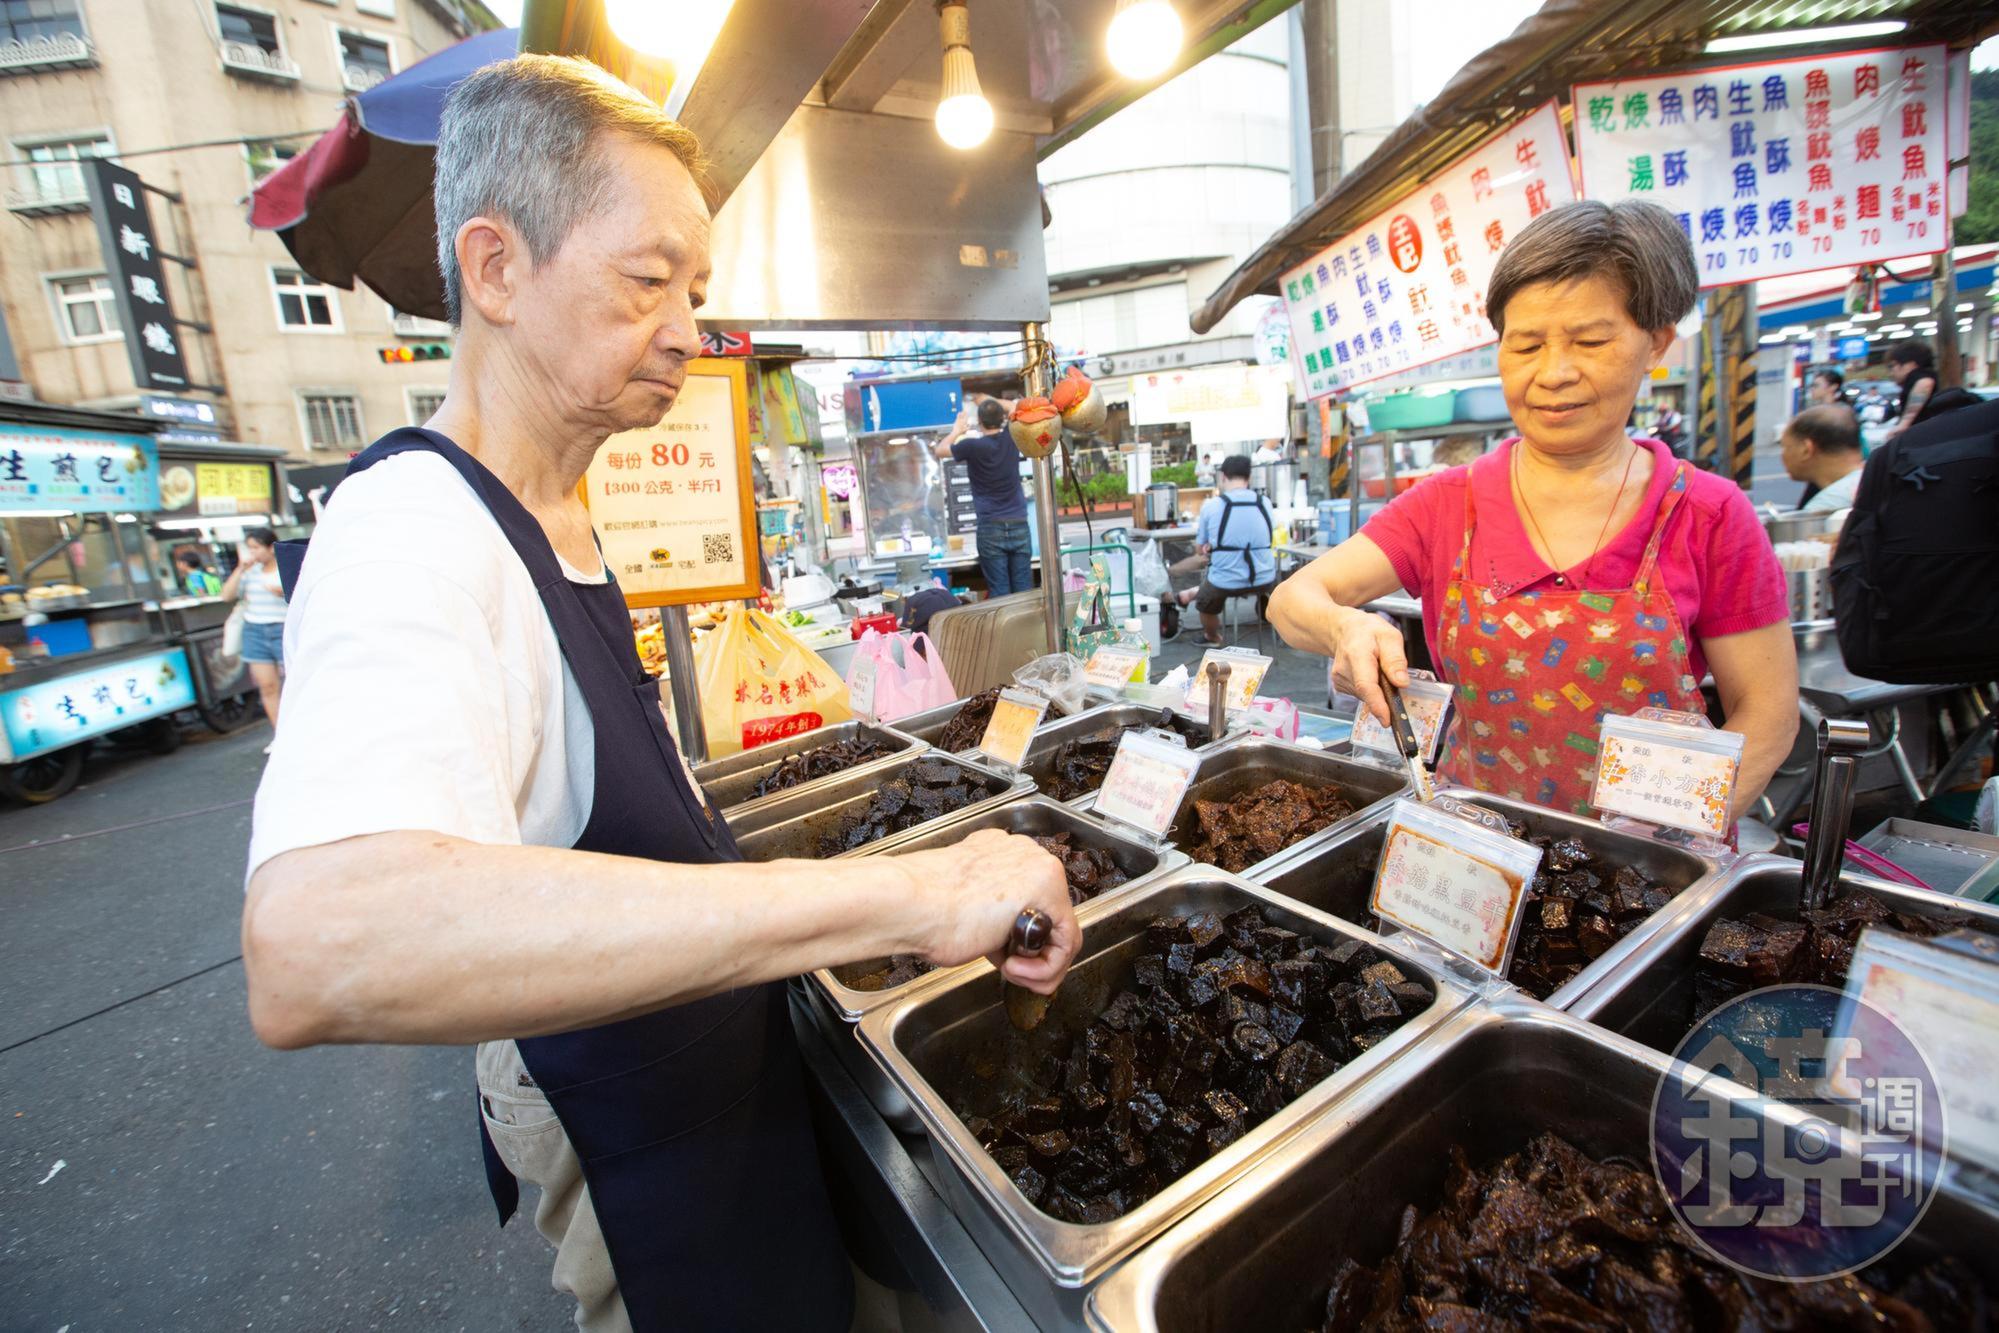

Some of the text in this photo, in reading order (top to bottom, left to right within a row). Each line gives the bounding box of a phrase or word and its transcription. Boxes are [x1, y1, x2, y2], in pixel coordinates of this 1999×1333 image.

[1588, 95, 1616, 133] 乾
[1902, 56, 1928, 181] 生魷魚
[1861, 228, 1881, 246] 70
[1907, 221, 1927, 239] 70
[1772, 241, 1792, 261] 70
[1812, 236, 1832, 254] 70
[1706, 253, 1726, 271] 70
[1739, 247, 1759, 266] 70
[1360, 361, 1373, 376] 70
[607, 443, 715, 469] 每份 80 元
[645, 481, 674, 495] 公克
